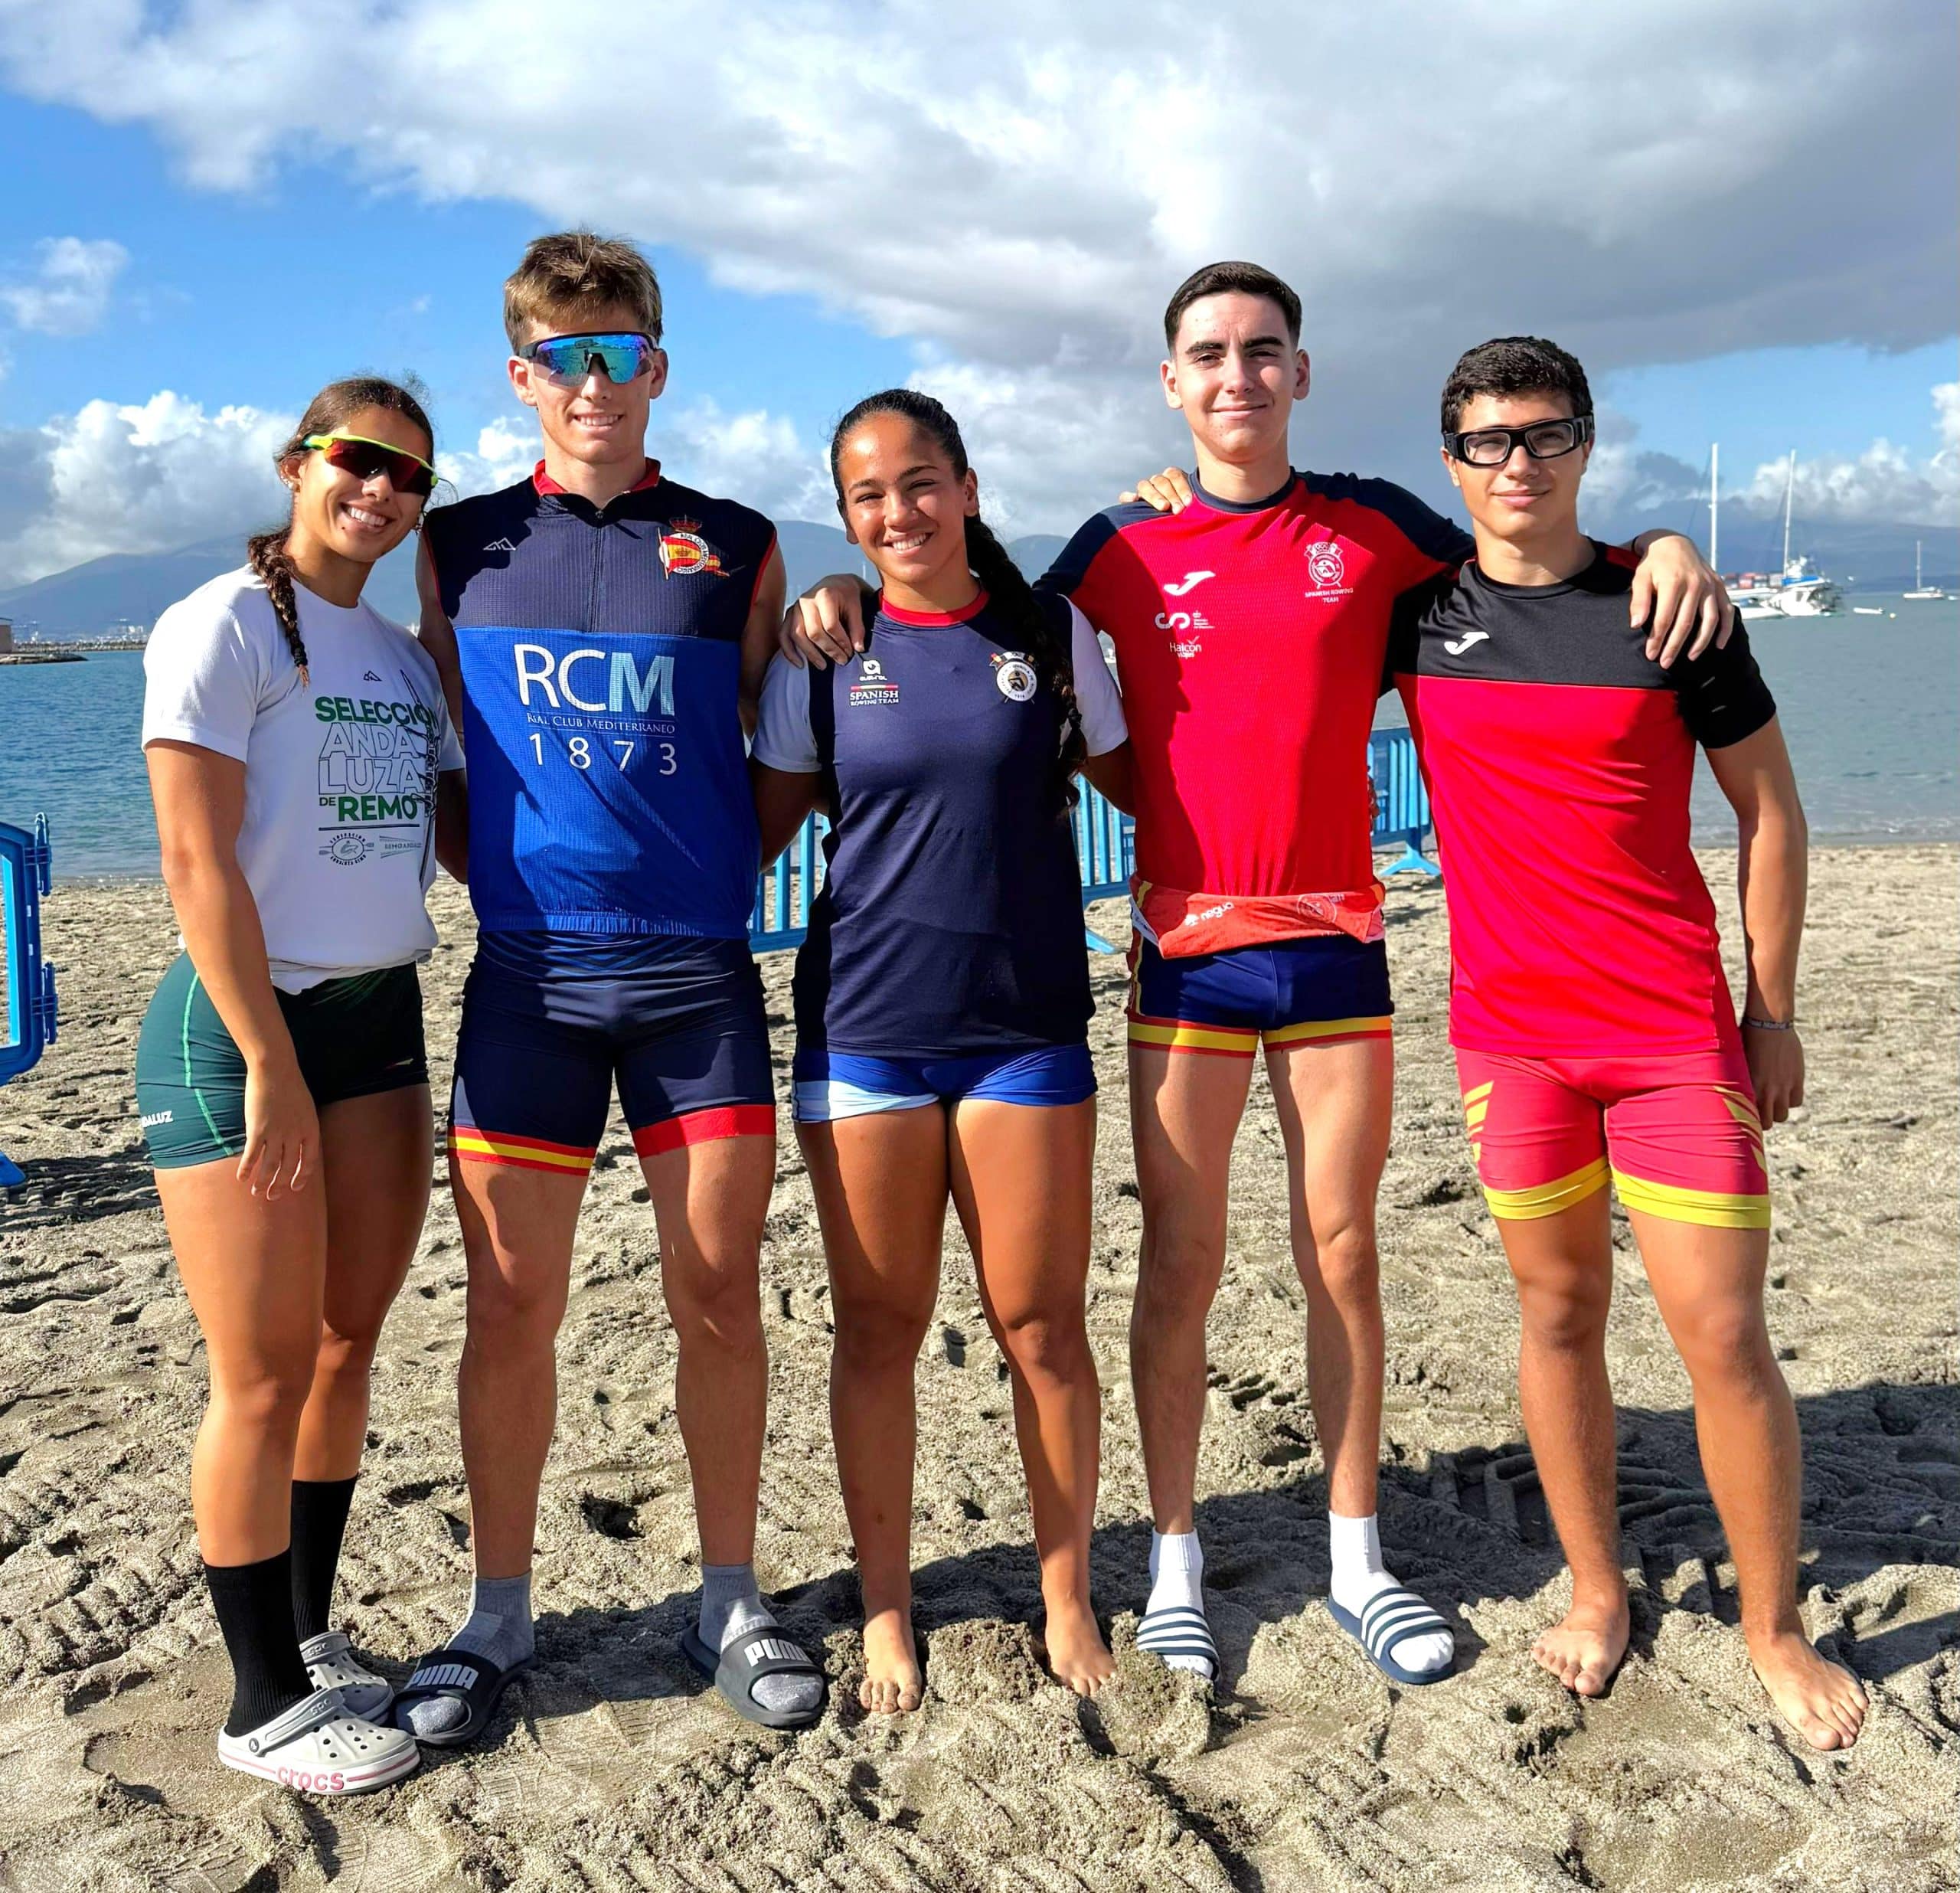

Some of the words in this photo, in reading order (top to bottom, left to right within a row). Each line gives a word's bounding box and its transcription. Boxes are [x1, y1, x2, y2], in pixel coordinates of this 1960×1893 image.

[514, 643, 675, 716] RCM
[850, 690, 899, 700] SPANISH
[553, 715, 583, 727] CLUB
[586, 719, 675, 734] MEDITERRANEO
[319, 796, 336, 807] DE
[338, 794, 418, 822] REMO
[404, 1664, 479, 1691] PUMA
[277, 1767, 345, 1791] crocs
